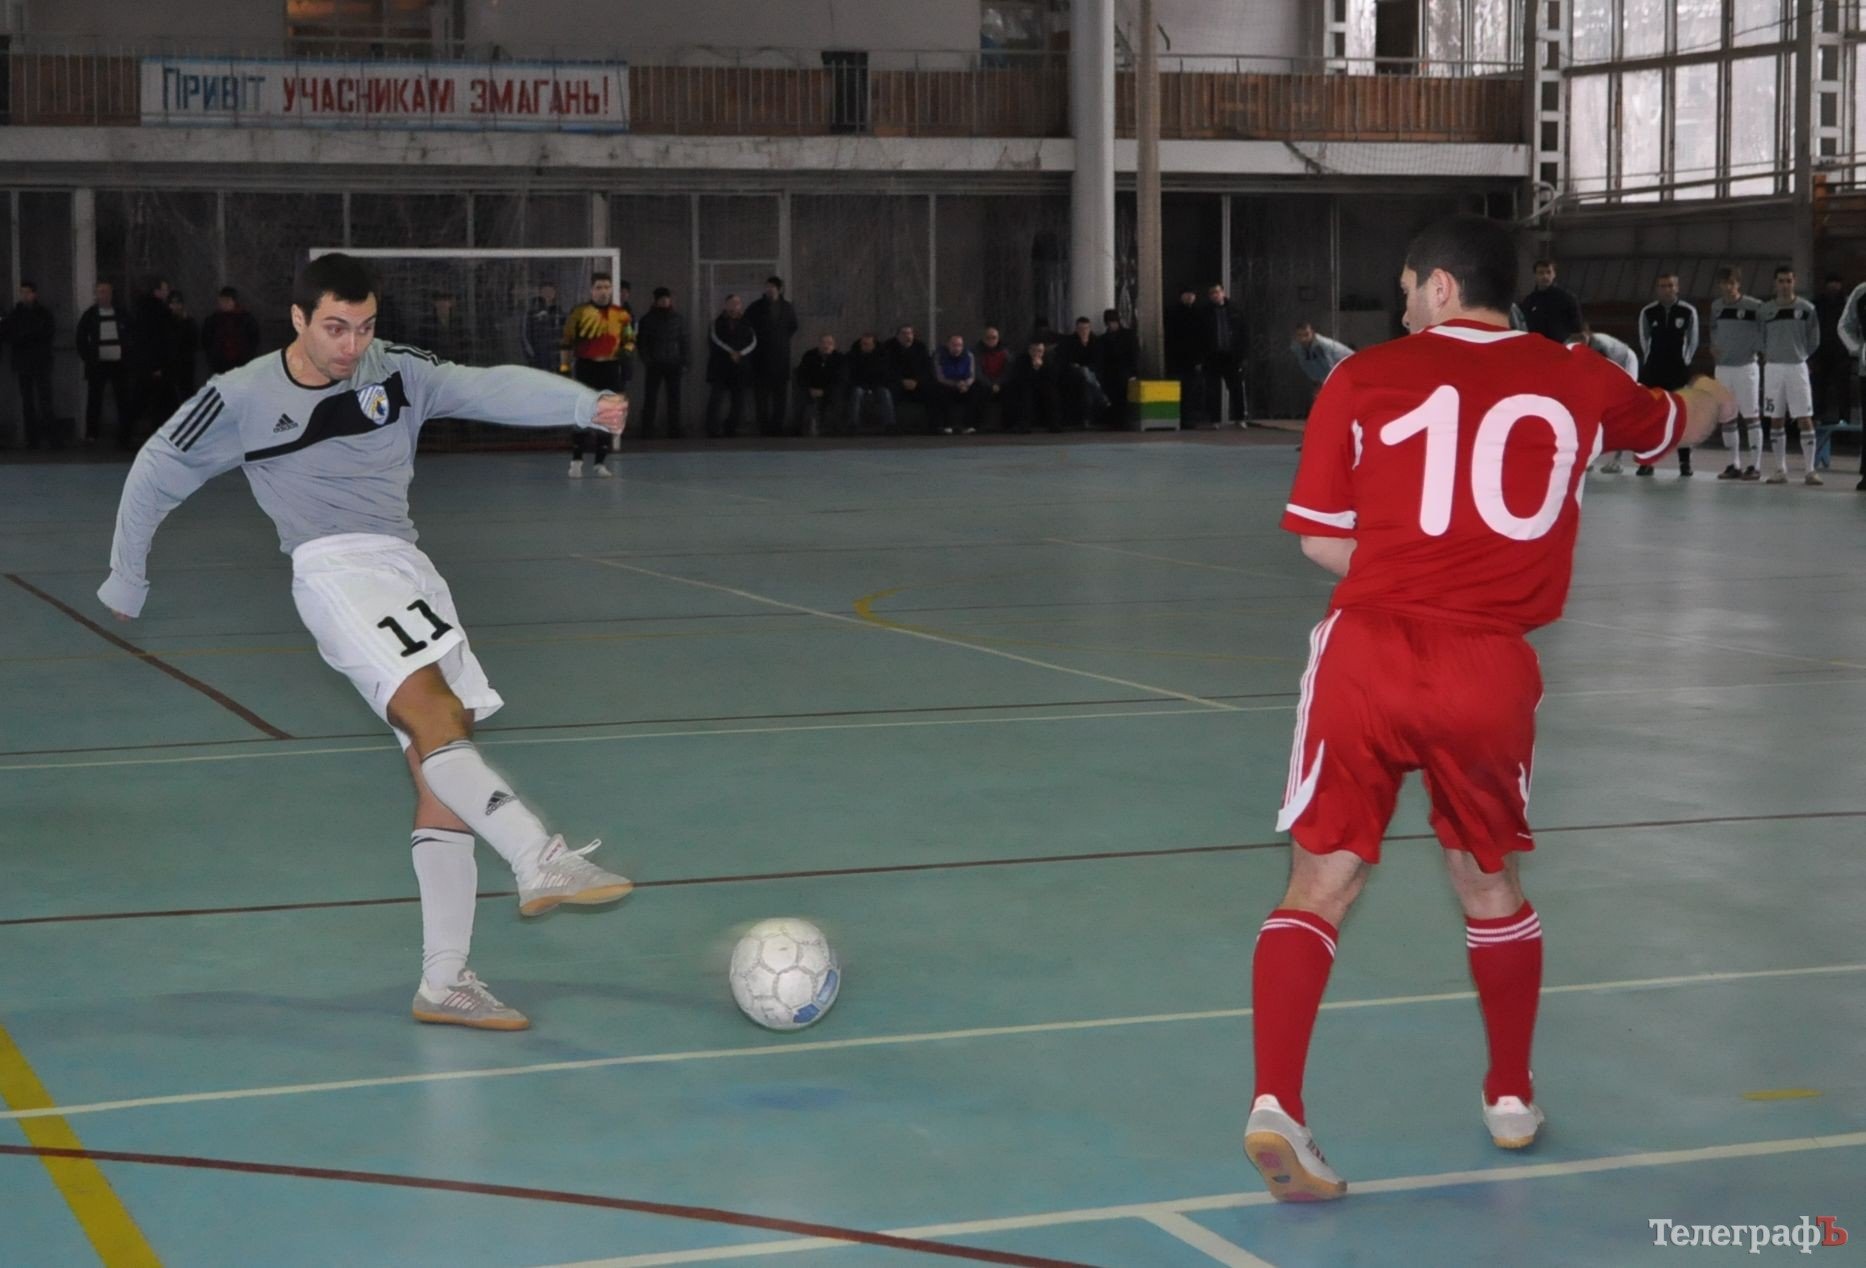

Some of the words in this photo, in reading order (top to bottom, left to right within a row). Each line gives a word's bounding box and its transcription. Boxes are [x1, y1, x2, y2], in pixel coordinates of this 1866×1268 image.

[283, 76, 456, 113] УЧАСНИКАМ
[469, 75, 609, 115] ЗМАГАНЬ!
[1380, 384, 1579, 541] 10
[377, 598, 454, 657] 11
